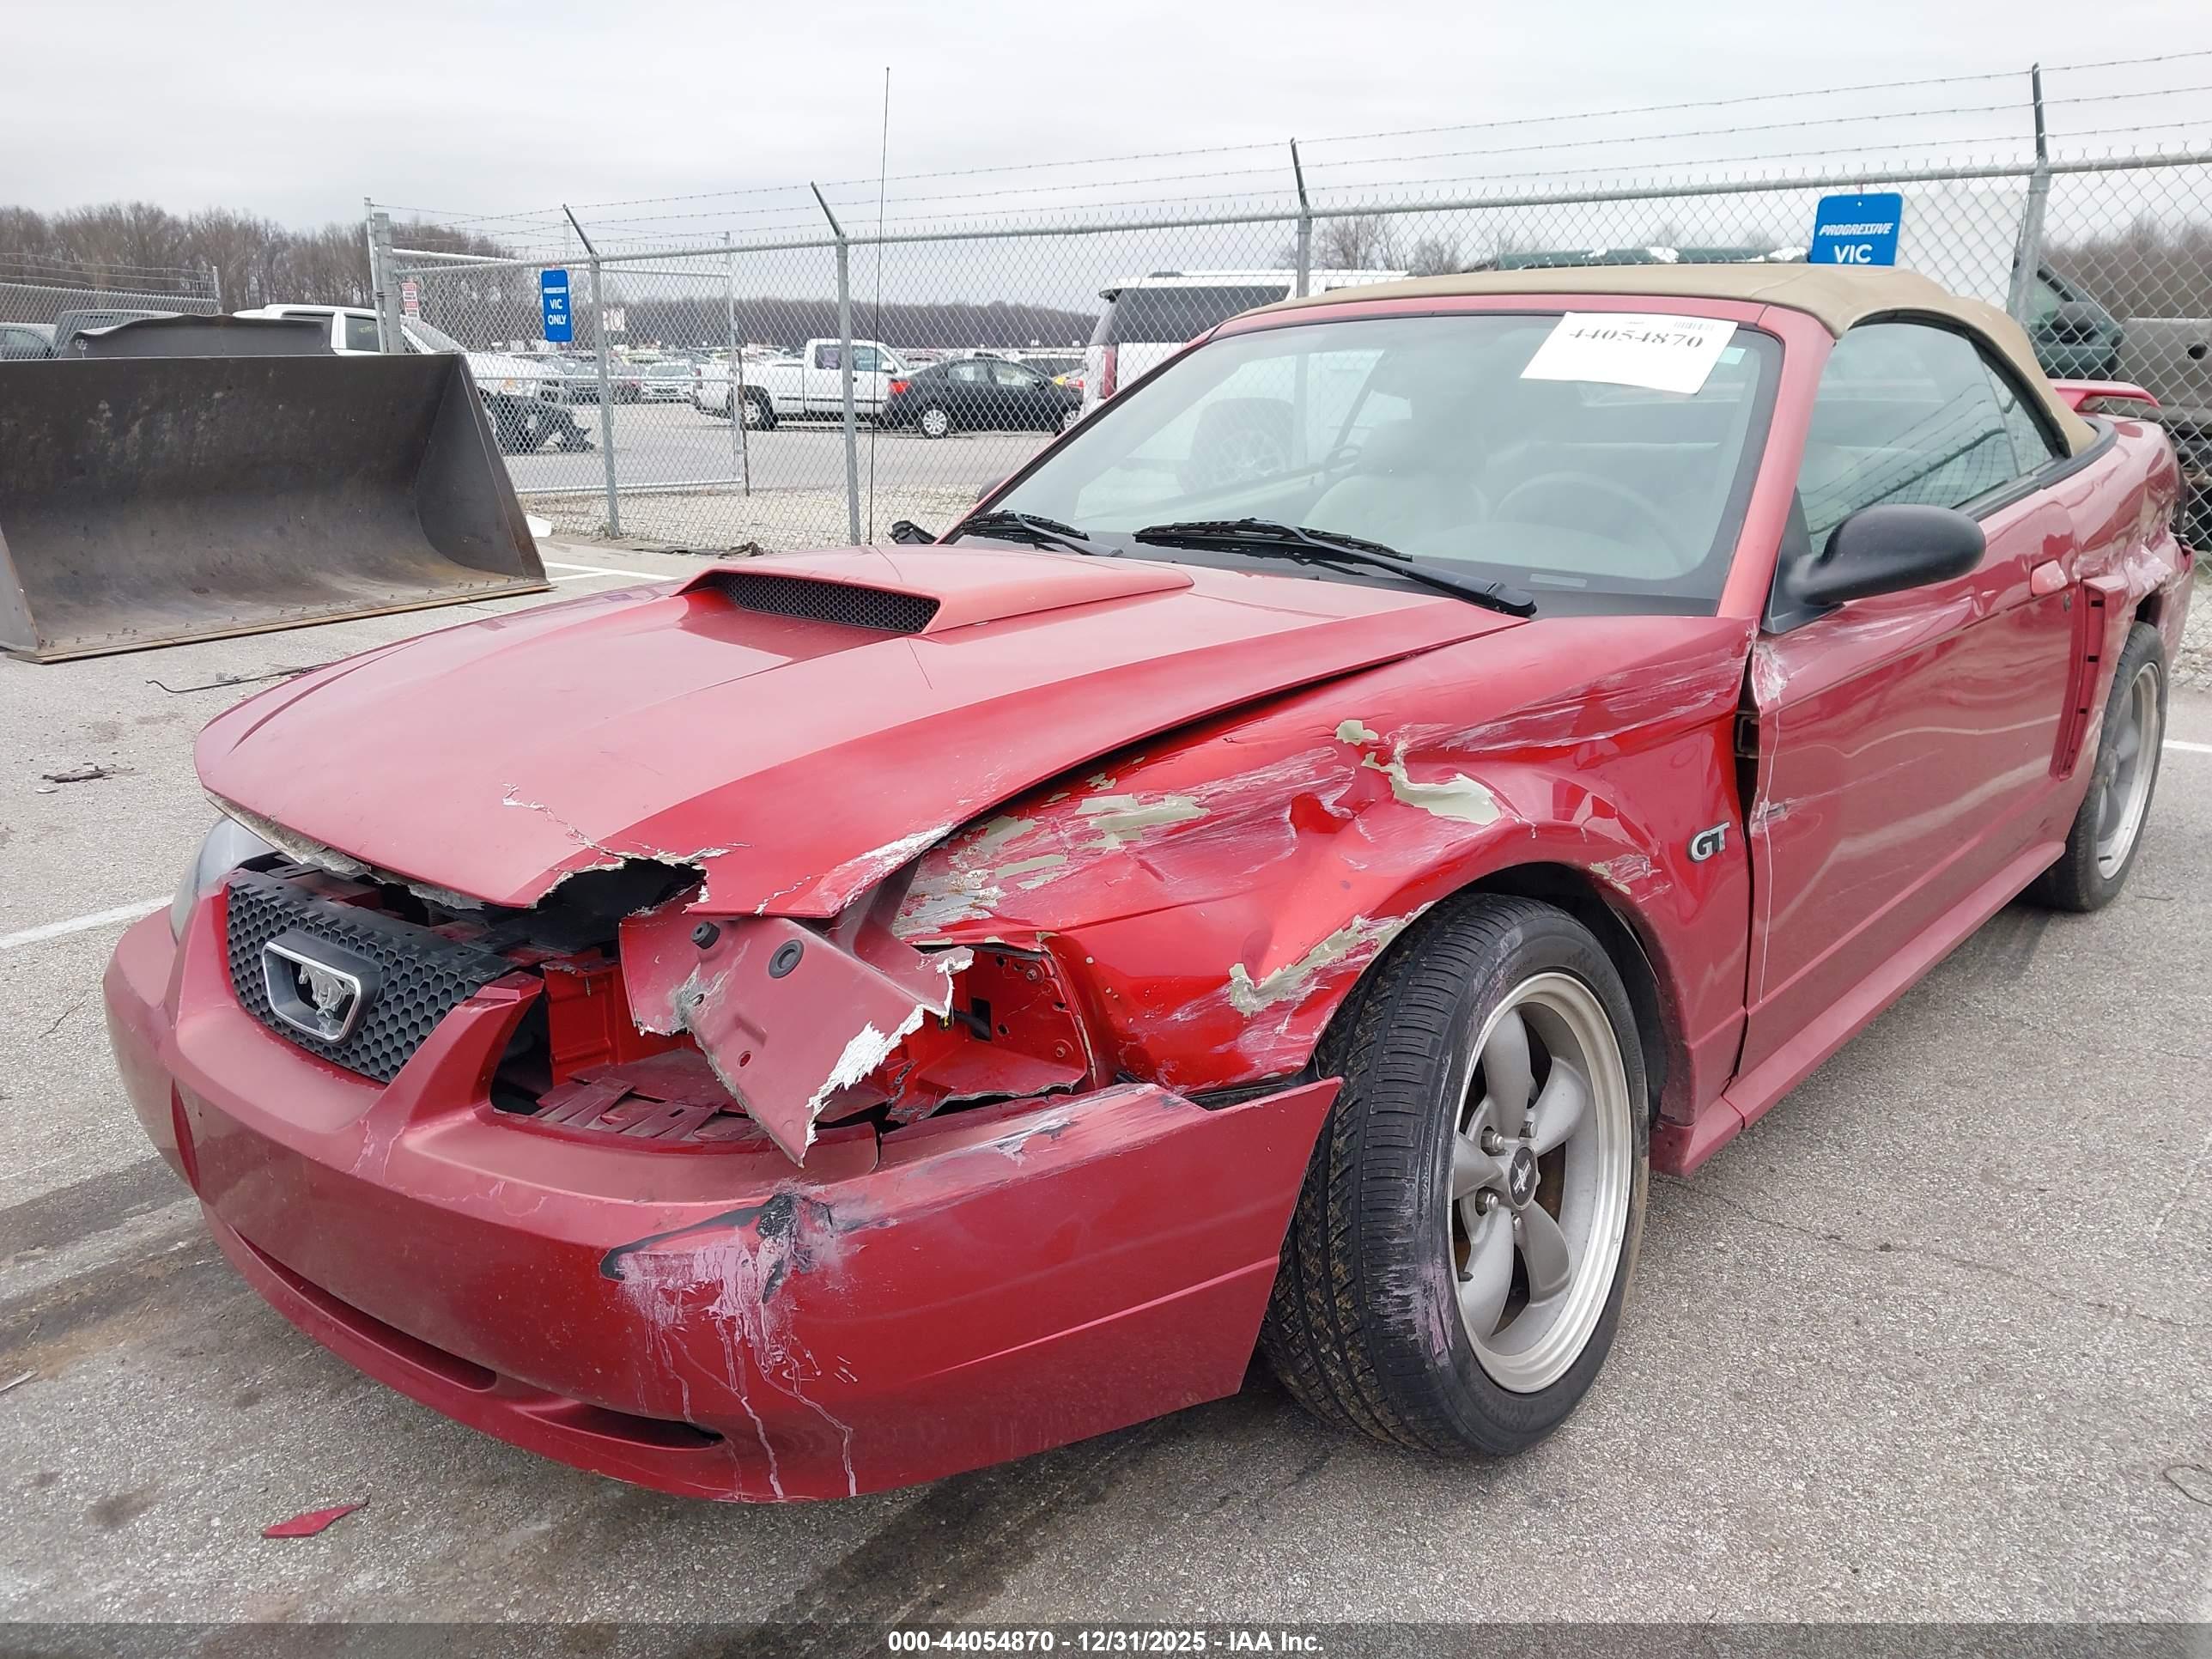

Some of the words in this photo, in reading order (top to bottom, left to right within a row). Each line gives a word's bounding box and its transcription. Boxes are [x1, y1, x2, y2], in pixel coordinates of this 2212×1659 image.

[1819, 222, 1893, 236] PROGRESSIVE
[1834, 244, 1873, 264] VIC
[550, 299, 562, 309] VIC
[547, 314, 566, 325] ONLY
[1570, 328, 1704, 348] 44054870
[1690, 821, 1731, 862] GT
